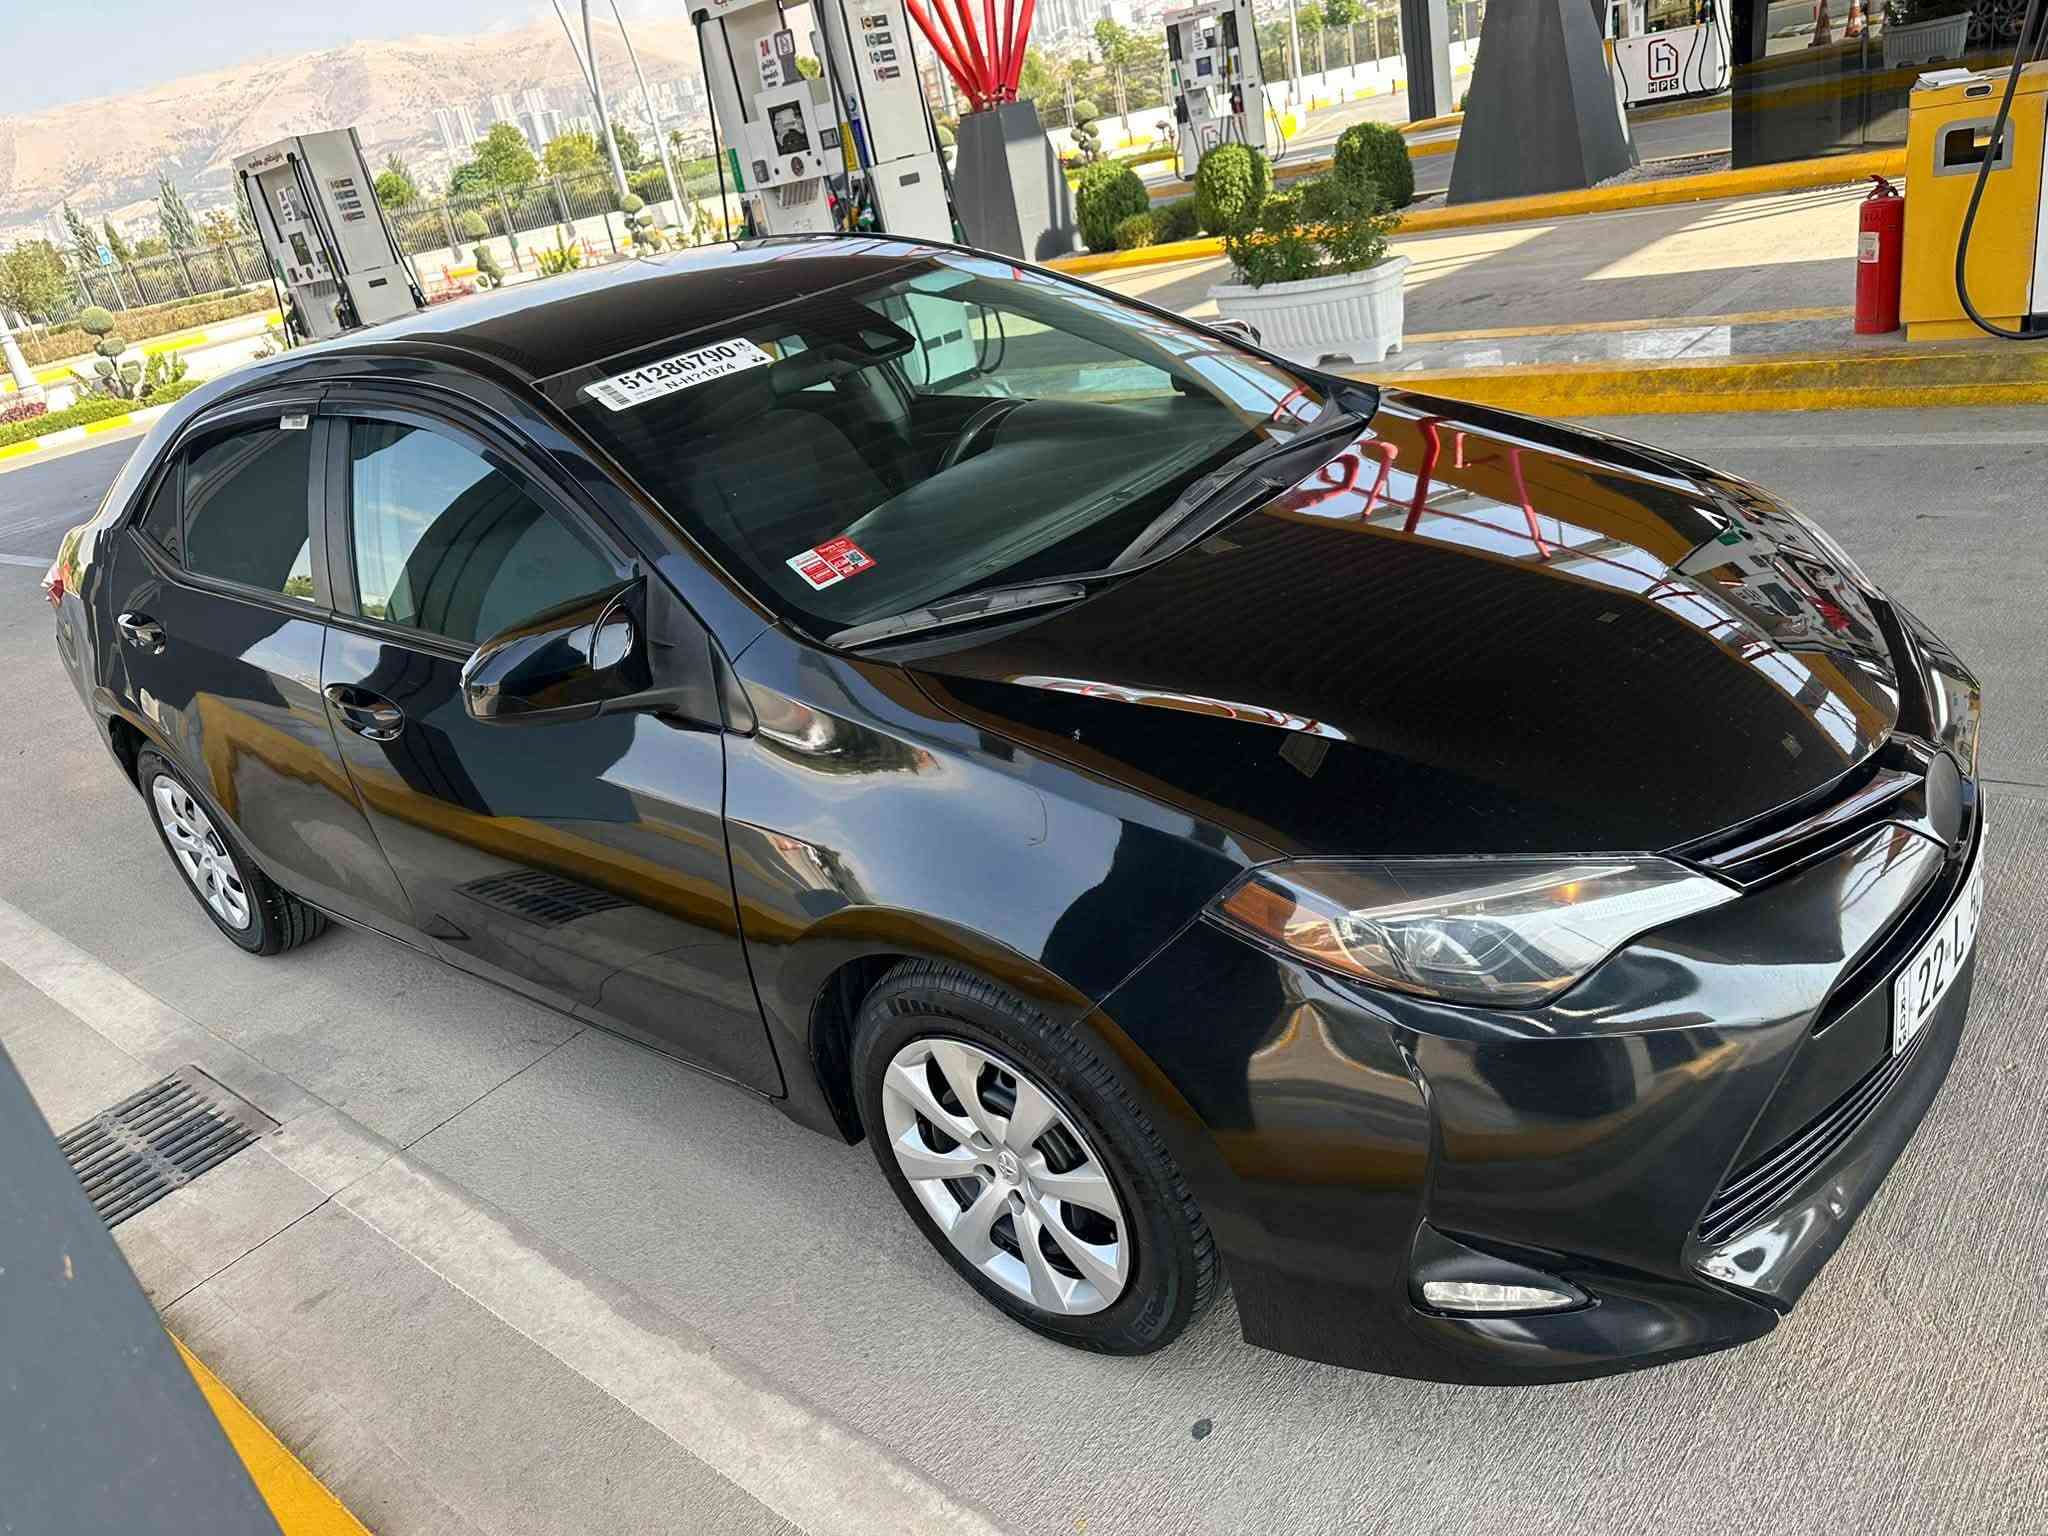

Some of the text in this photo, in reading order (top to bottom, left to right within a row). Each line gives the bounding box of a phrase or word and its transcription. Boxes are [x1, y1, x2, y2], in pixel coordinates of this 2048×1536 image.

[1648, 79, 1679, 93] HPS
[617, 345, 737, 389] 51286790
[1918, 937, 1945, 1019] 22
